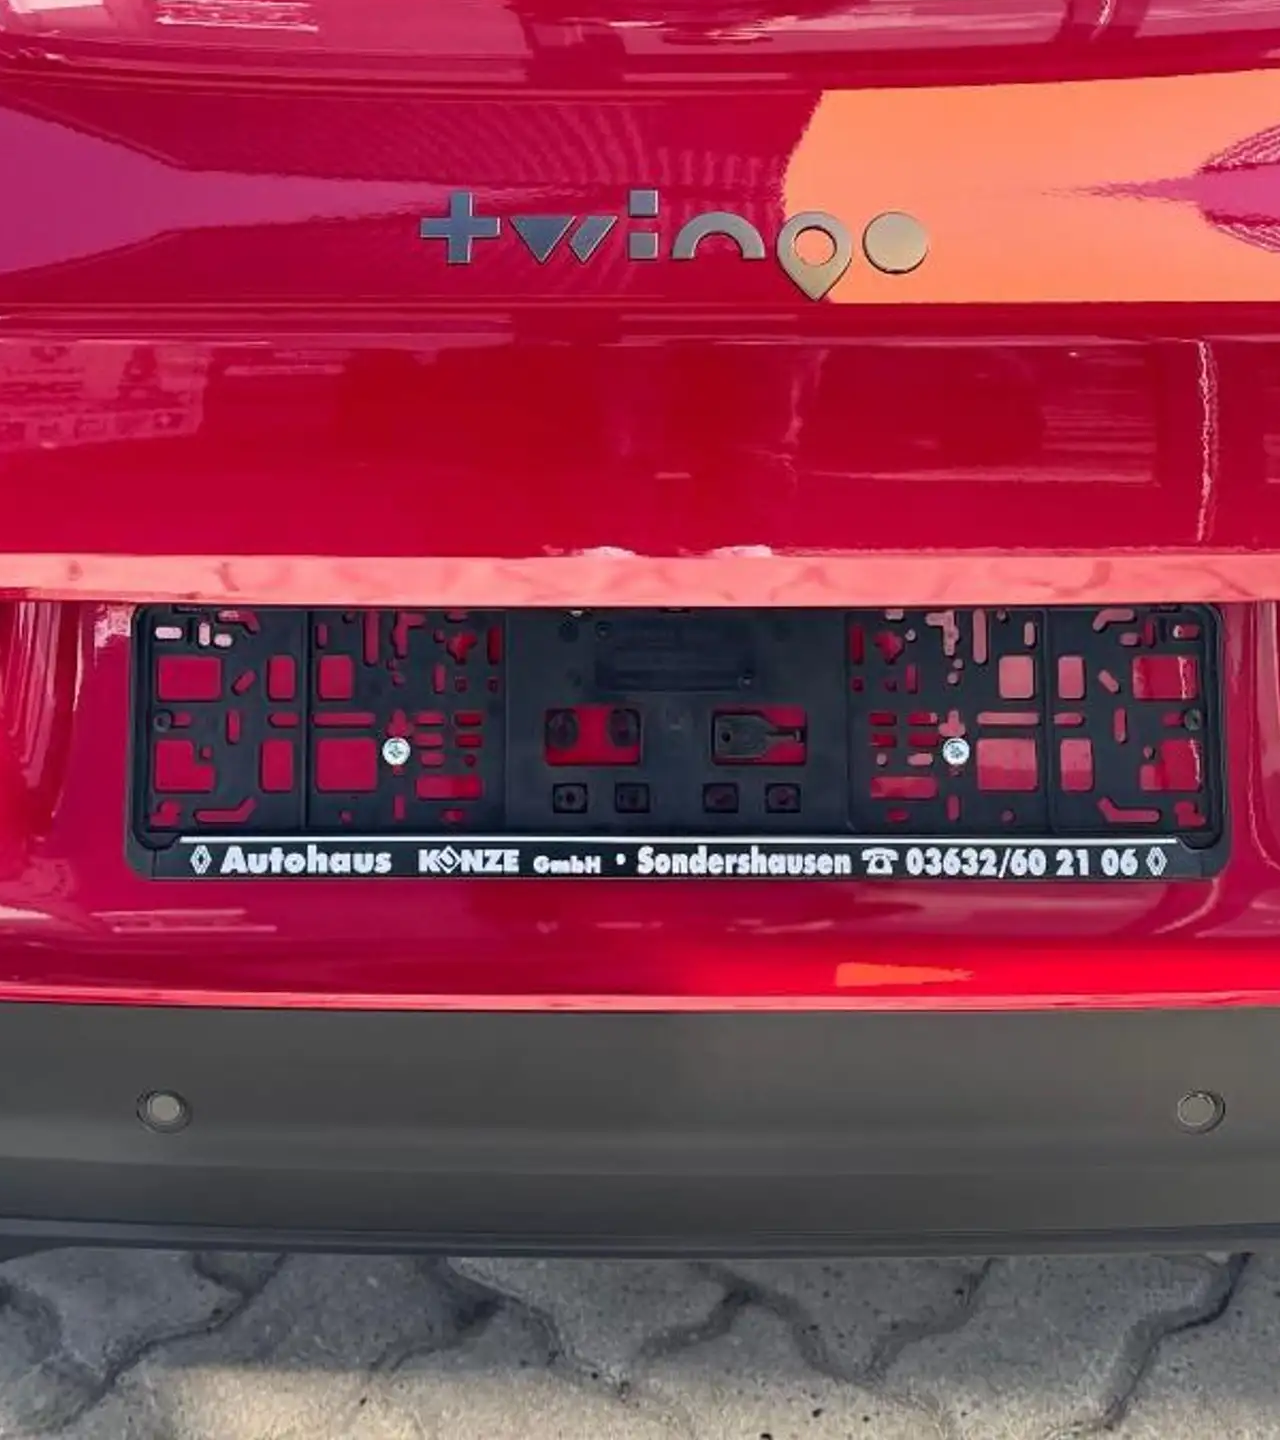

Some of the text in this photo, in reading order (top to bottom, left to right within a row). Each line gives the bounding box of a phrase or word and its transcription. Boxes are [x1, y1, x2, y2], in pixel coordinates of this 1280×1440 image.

[221, 844, 393, 874] Autohaus
[532, 854, 602, 875] GmbH
[637, 844, 852, 876] Sondershausen
[906, 847, 1047, 878] 03632/60
[1056, 847, 1090, 876] 21
[1101, 847, 1139, 876] 06
